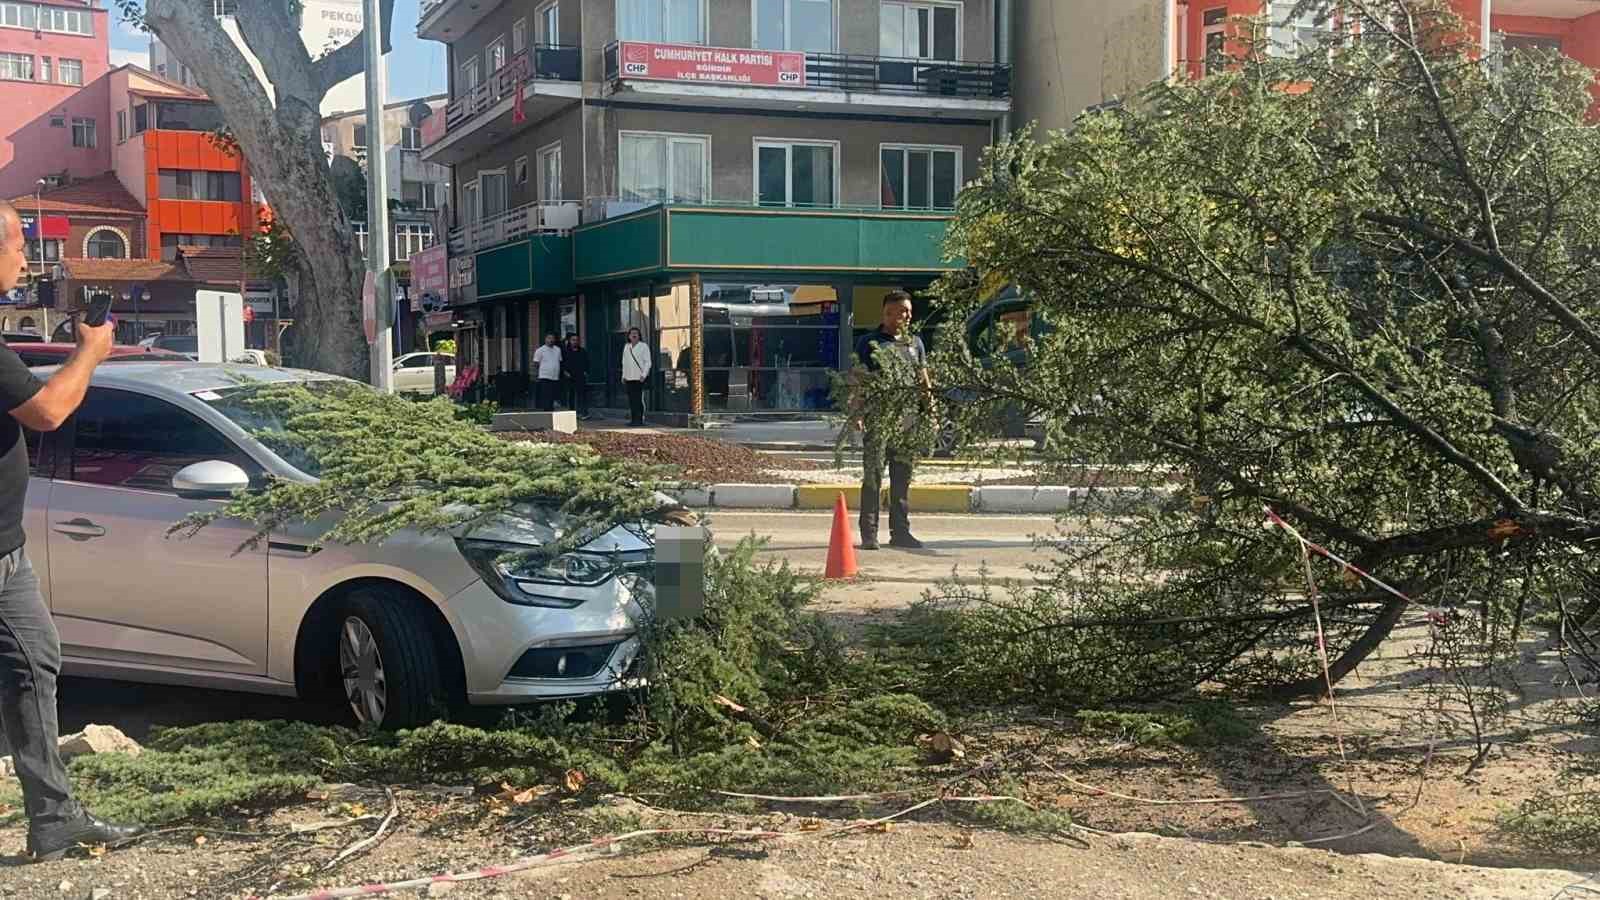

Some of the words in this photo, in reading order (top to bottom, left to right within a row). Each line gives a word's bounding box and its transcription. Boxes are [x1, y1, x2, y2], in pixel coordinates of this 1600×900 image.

[654, 48, 712, 61] CUMHURİYET
[715, 52, 738, 63] HALK
[740, 54, 773, 65] PARTİSİ
[626, 64, 646, 73] CHP
[780, 73, 798, 81] CHP
